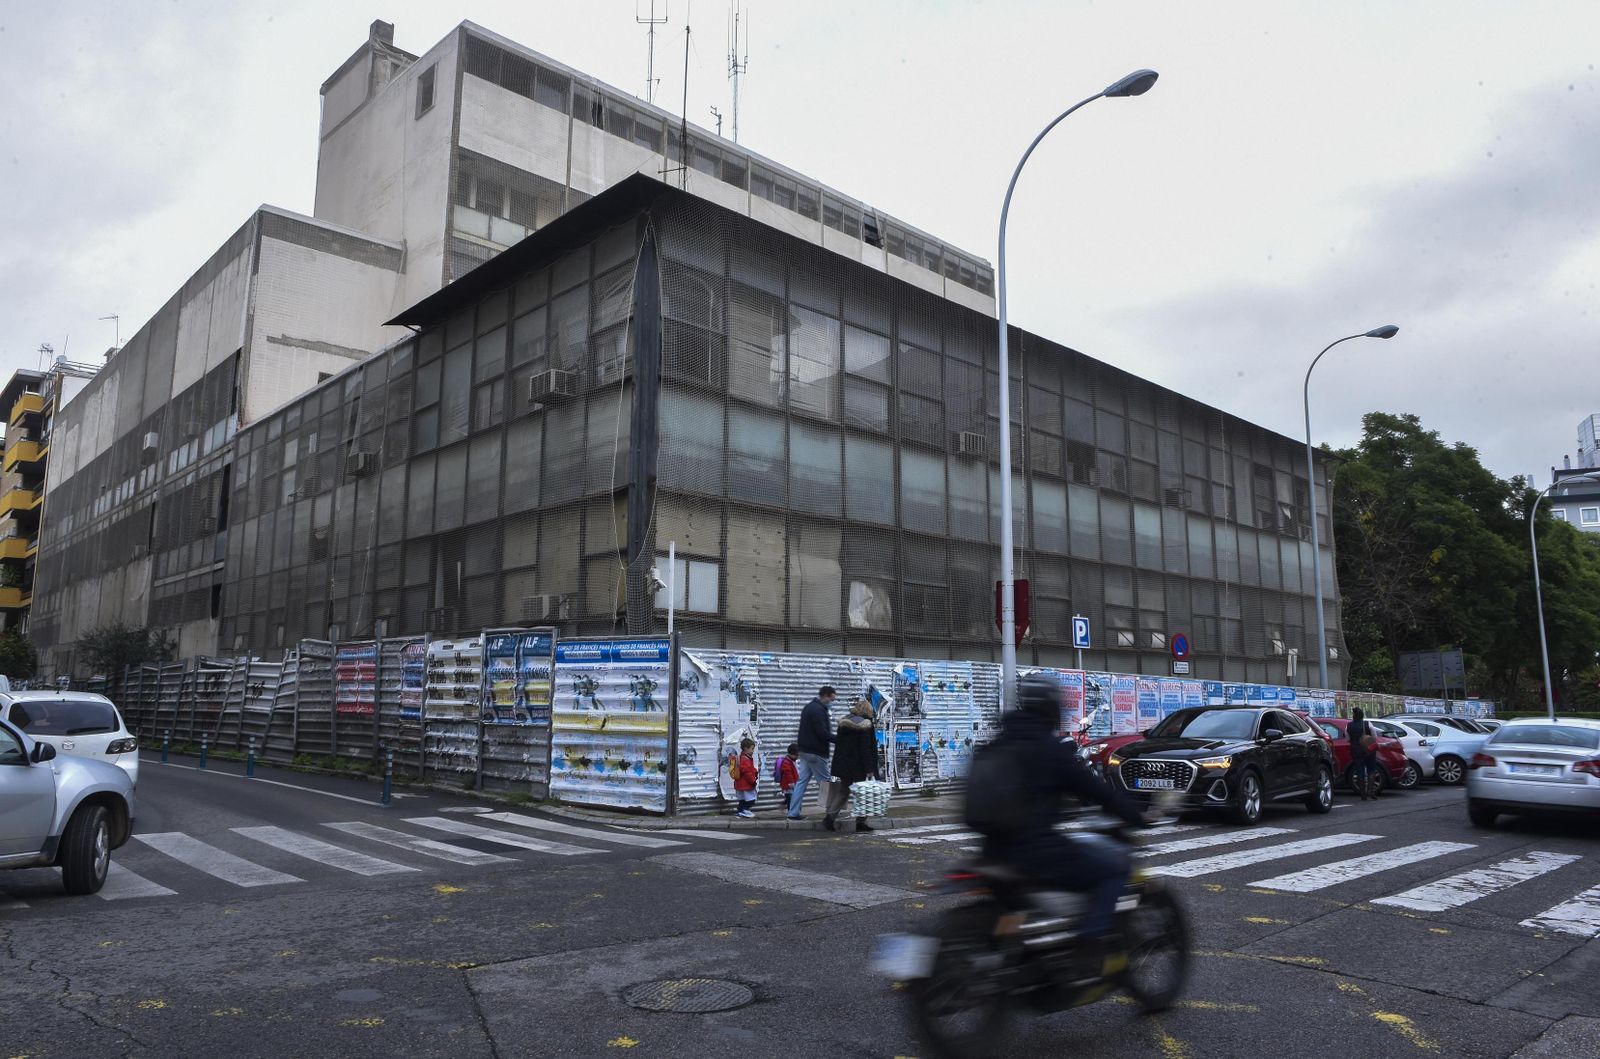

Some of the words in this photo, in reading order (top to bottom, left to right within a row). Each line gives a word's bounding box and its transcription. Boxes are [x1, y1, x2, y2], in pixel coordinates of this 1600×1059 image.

[1075, 620, 1086, 645] P
[491, 638, 504, 650] ILF
[525, 636, 539, 648] ILF
[580, 643, 598, 651] FRANCÉS
[1140, 779, 1157, 787] 2092
